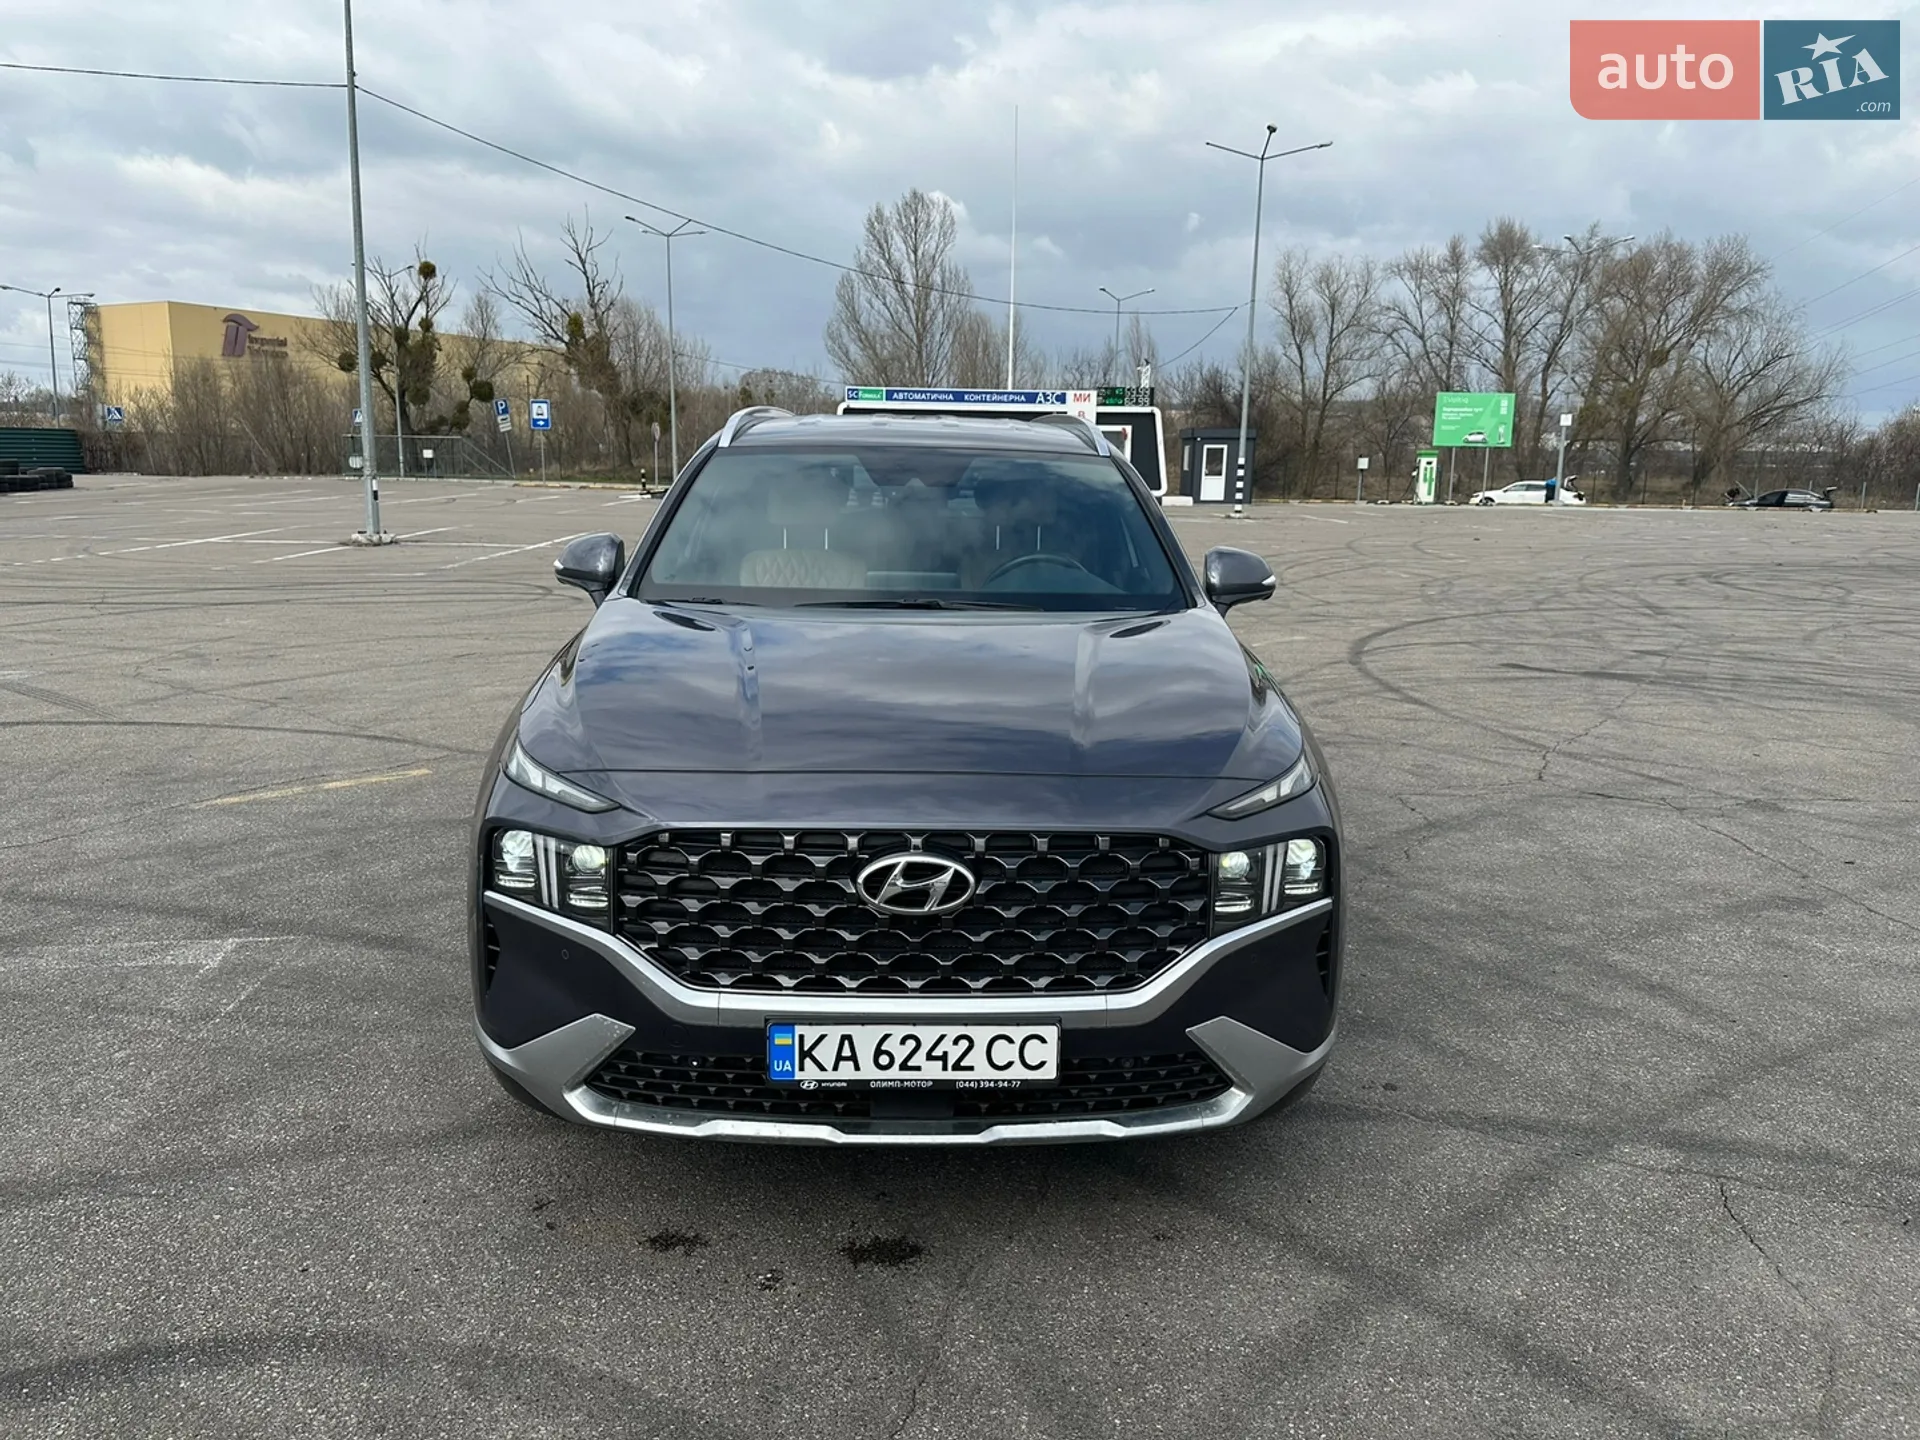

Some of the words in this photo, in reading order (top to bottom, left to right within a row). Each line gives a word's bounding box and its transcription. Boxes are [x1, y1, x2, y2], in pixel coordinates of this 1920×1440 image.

[892, 392, 955, 401] АВТОМАТИЧНА
[963, 393, 1027, 402] КОНТЕЙНЕРНА
[1035, 391, 1062, 404] АЗС
[497, 401, 506, 414] P
[798, 1033, 861, 1072] KA
[873, 1033, 975, 1072] 6242
[985, 1033, 1048, 1072] CC
[774, 1060, 792, 1071] UA
[956, 1081, 978, 1089] (044)
